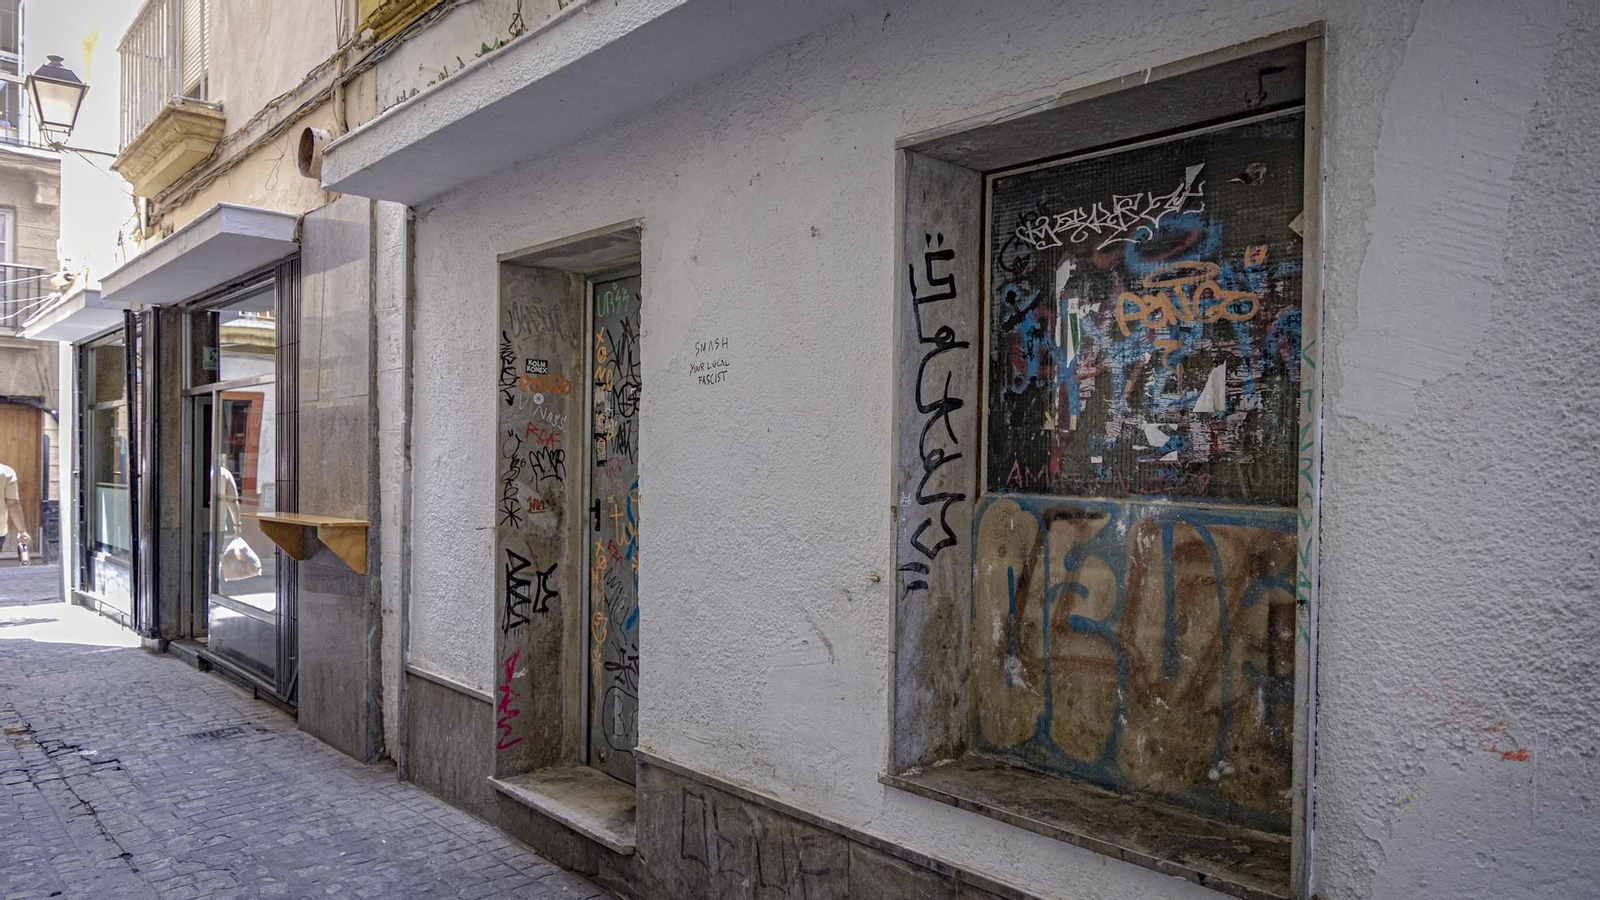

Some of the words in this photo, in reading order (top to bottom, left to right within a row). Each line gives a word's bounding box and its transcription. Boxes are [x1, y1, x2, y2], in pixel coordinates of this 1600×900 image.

[694, 337, 729, 357] SMASH
[690, 362, 705, 376] YOUR
[707, 359, 731, 371] LOCAL
[698, 370, 728, 386] FASCIST
